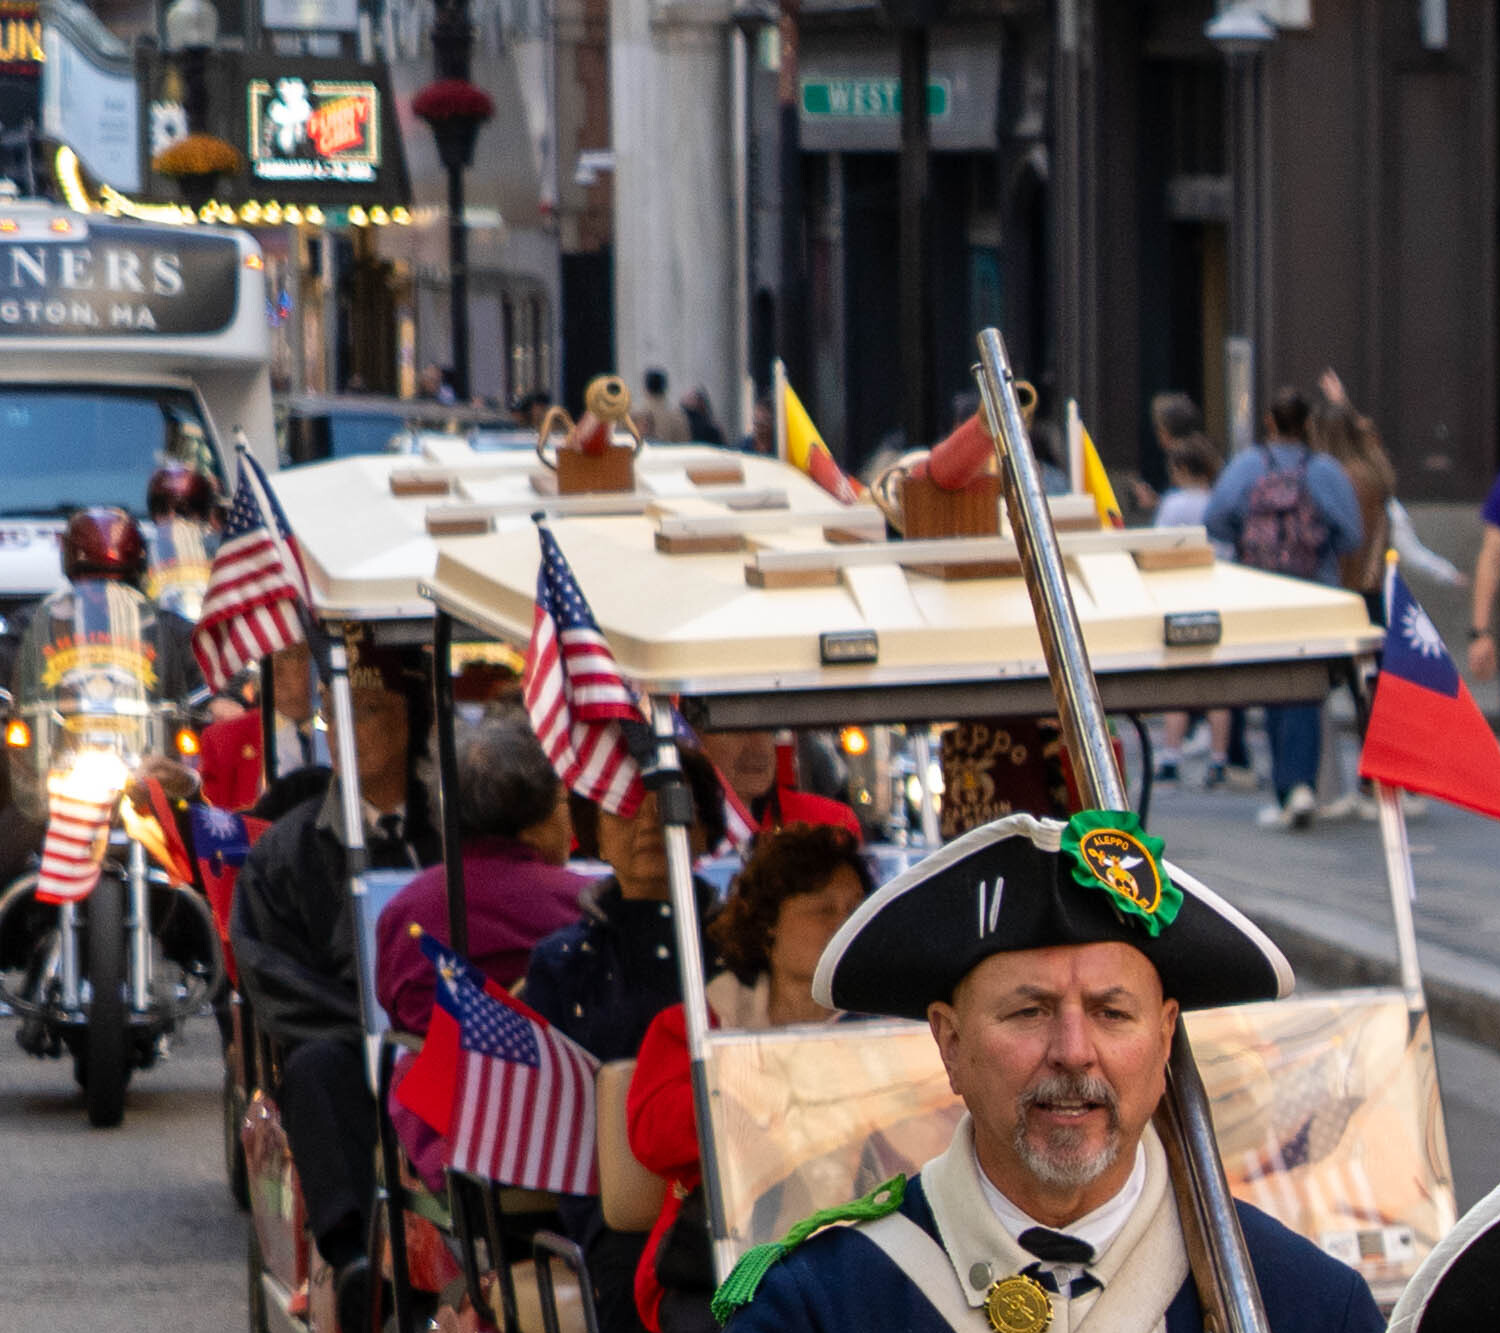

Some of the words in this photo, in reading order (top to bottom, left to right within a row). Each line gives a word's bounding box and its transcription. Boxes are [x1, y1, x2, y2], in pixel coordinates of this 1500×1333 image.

[829, 82, 901, 112] WEST
[9, 248, 184, 296] NERS
[111, 304, 157, 330] MA
[1093, 835, 1129, 851] ALEPPO
